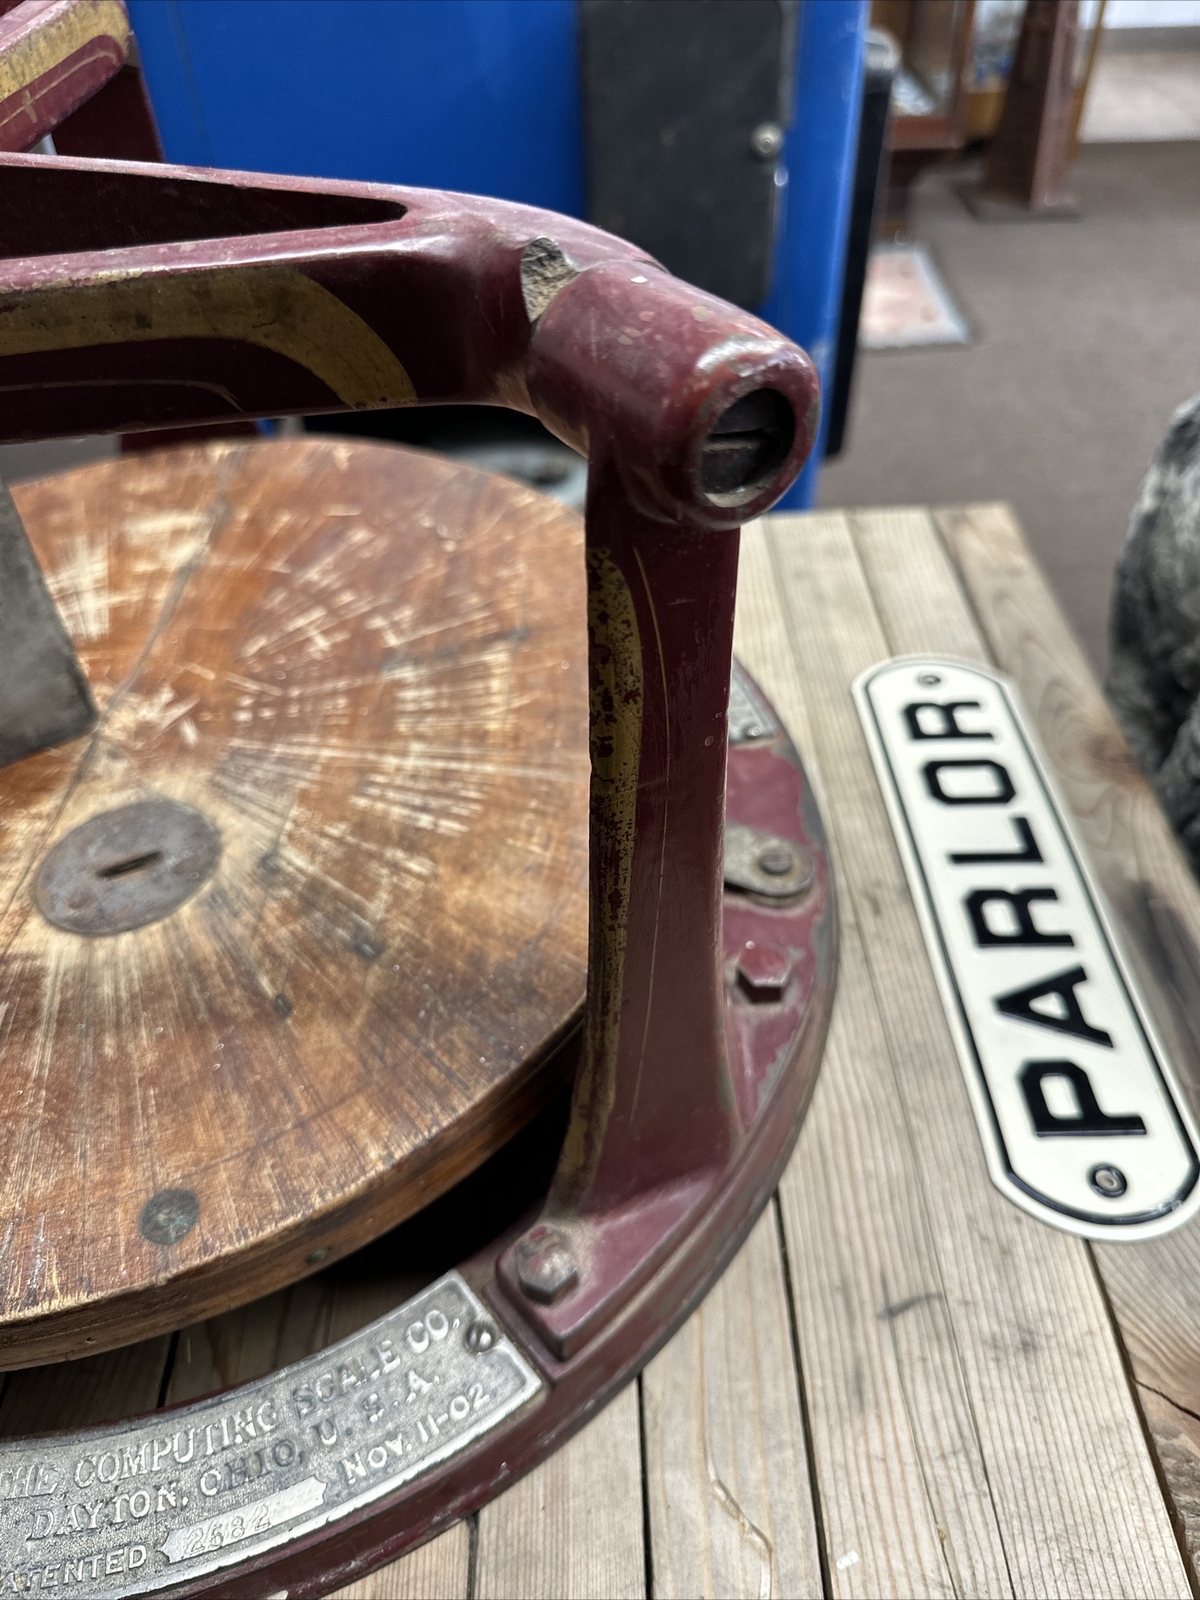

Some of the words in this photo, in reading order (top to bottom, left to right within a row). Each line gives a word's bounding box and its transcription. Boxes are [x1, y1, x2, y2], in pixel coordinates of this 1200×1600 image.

[902, 700, 1147, 1137] PARLOR
[74, 1402, 277, 1489] COMPUTING
[292, 1338, 401, 1418] SCALE
